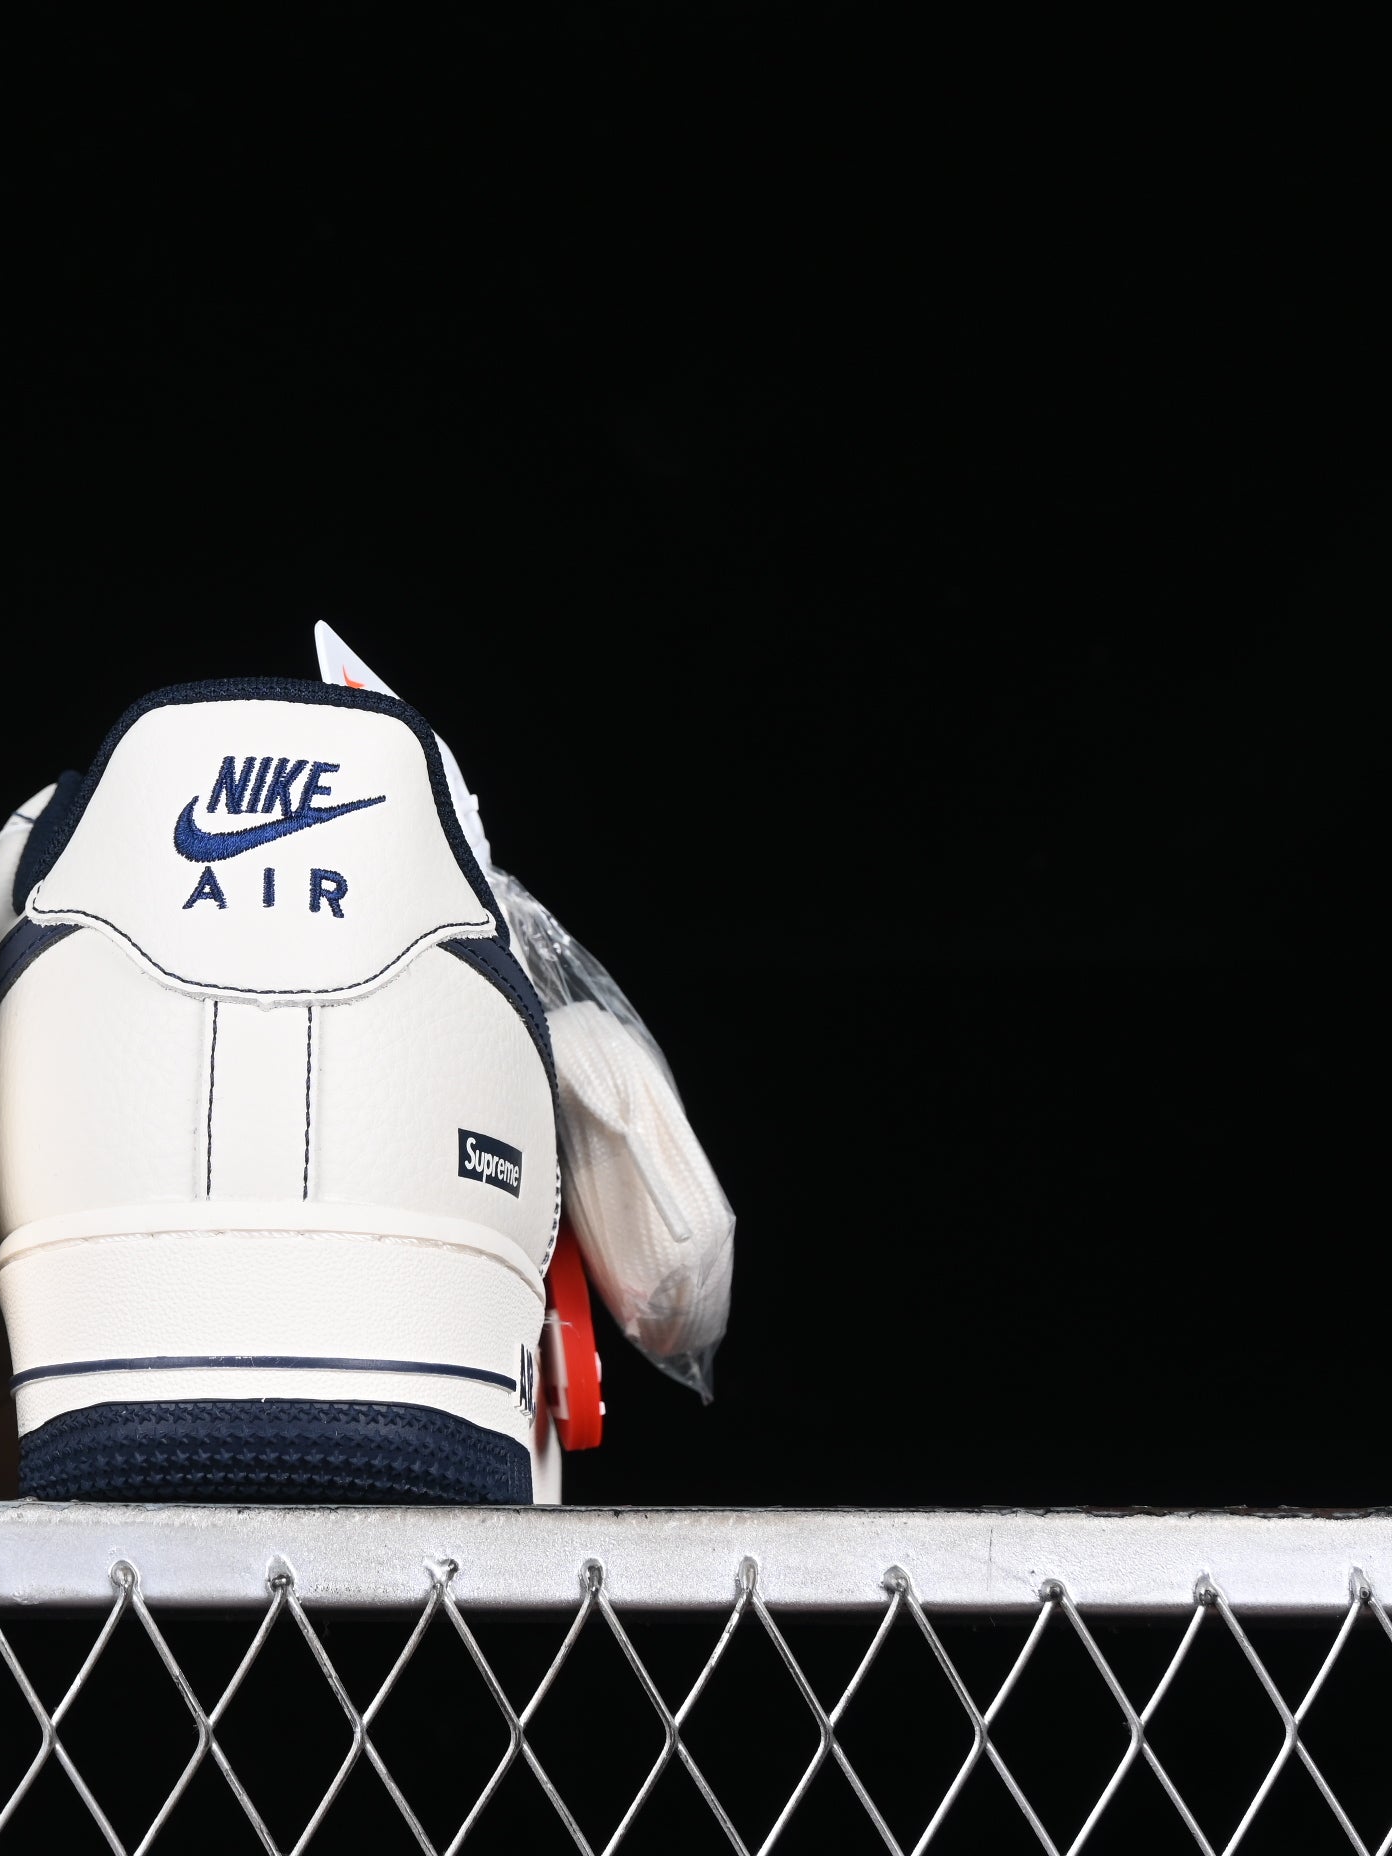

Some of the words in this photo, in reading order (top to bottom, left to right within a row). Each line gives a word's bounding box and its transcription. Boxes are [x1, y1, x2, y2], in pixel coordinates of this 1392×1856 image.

[206, 756, 340, 817] NIKE
[182, 866, 348, 918] AIR
[464, 1137, 520, 1187] Supreme
